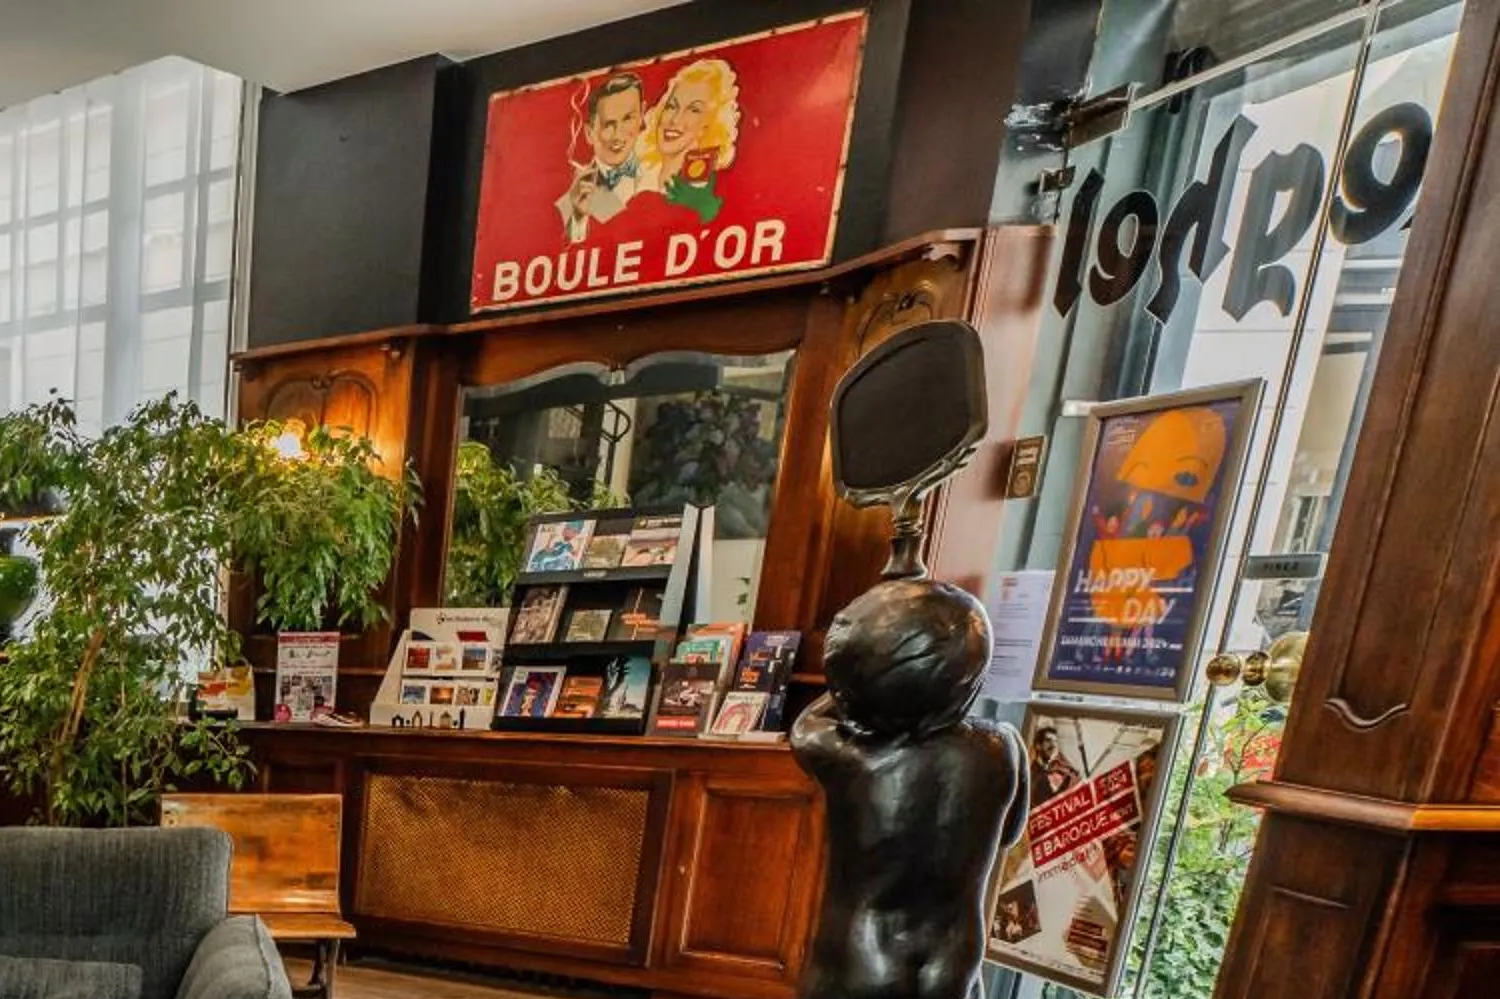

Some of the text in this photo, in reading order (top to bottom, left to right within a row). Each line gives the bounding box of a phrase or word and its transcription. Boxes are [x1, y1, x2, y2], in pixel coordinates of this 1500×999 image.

[492, 219, 787, 302] BOULE D'OR
[1074, 567, 1156, 593] HAPPY
[1122, 597, 1176, 625] DAY
[1029, 793, 1092, 834] FESTIVAL
